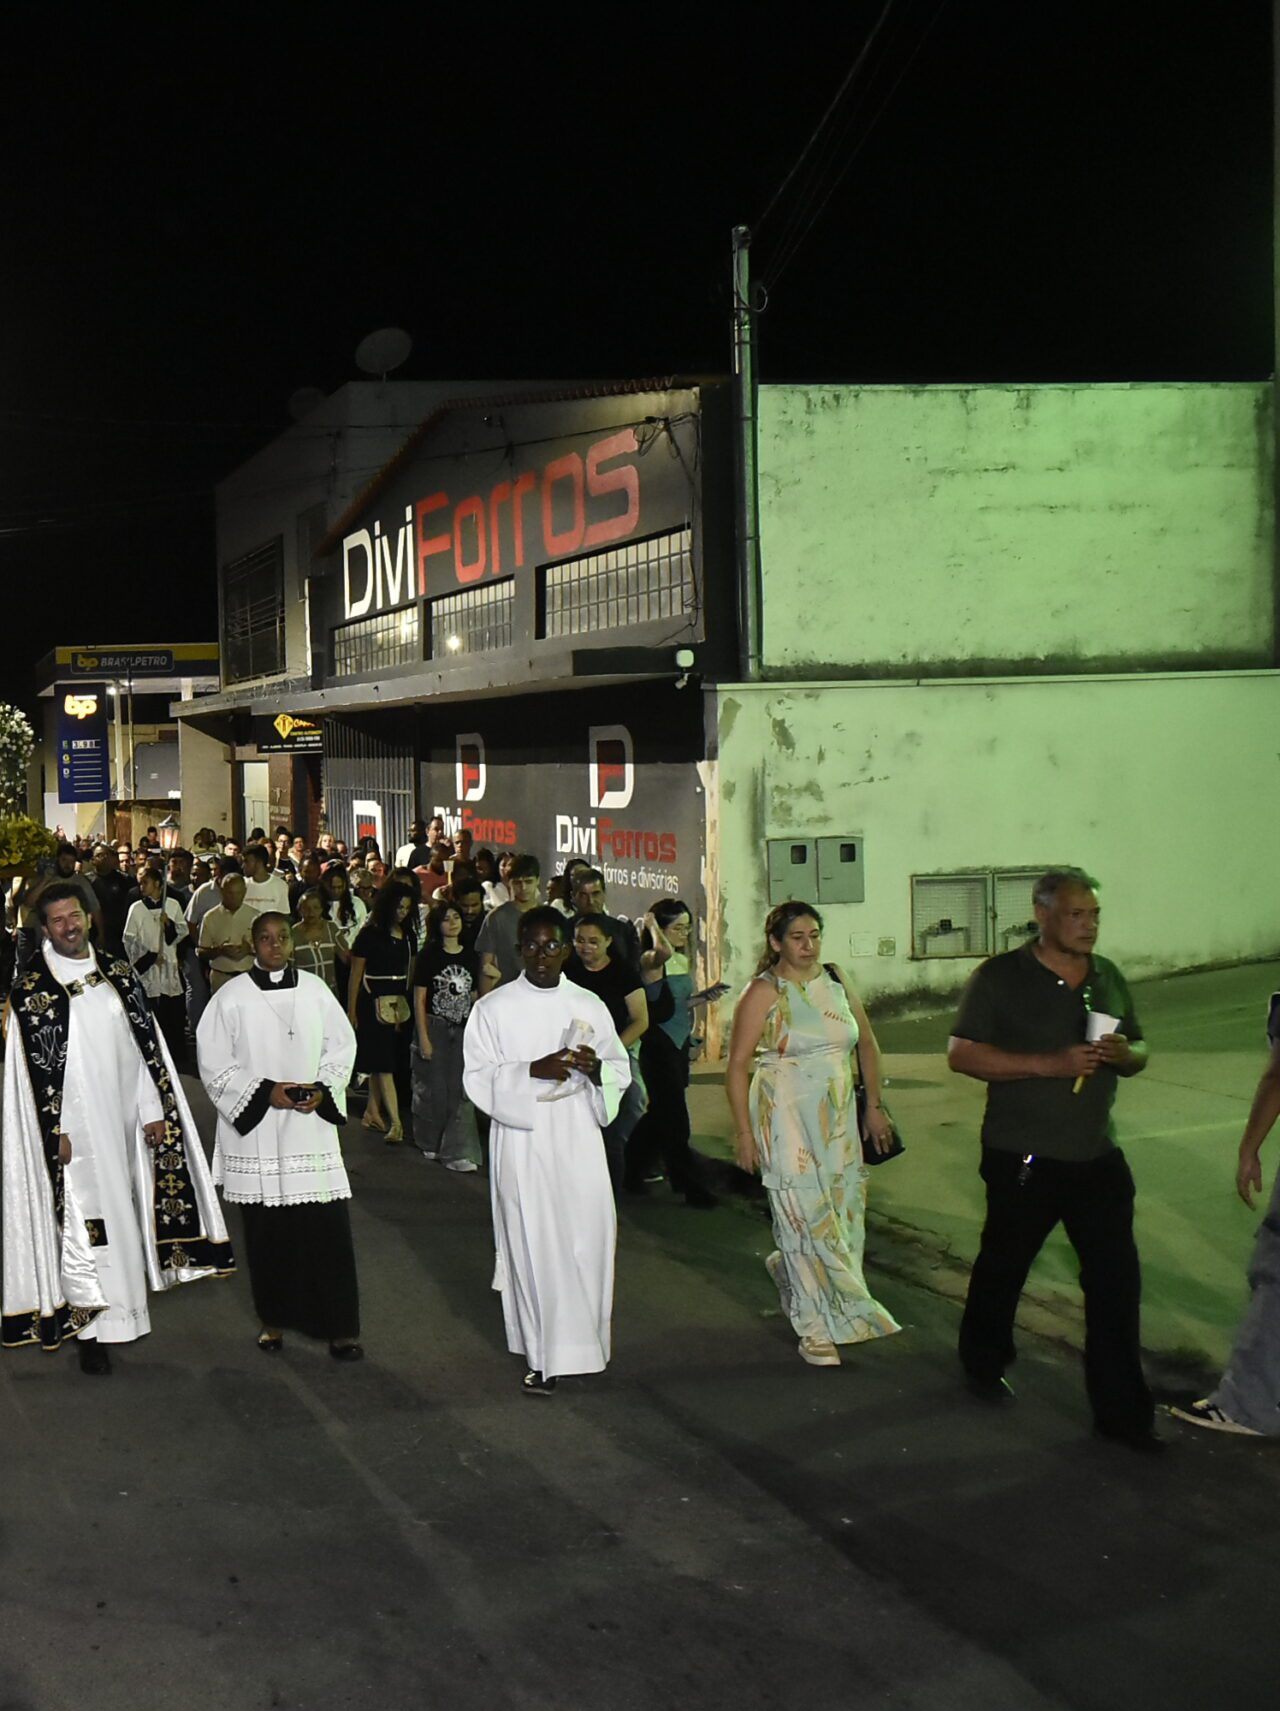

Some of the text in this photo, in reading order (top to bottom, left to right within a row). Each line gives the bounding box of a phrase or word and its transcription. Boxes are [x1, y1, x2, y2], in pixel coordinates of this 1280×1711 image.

[342, 428, 641, 620] DiviForros
[555, 815, 677, 863] DiviForros
[603, 862, 679, 894] forros e divisórias
